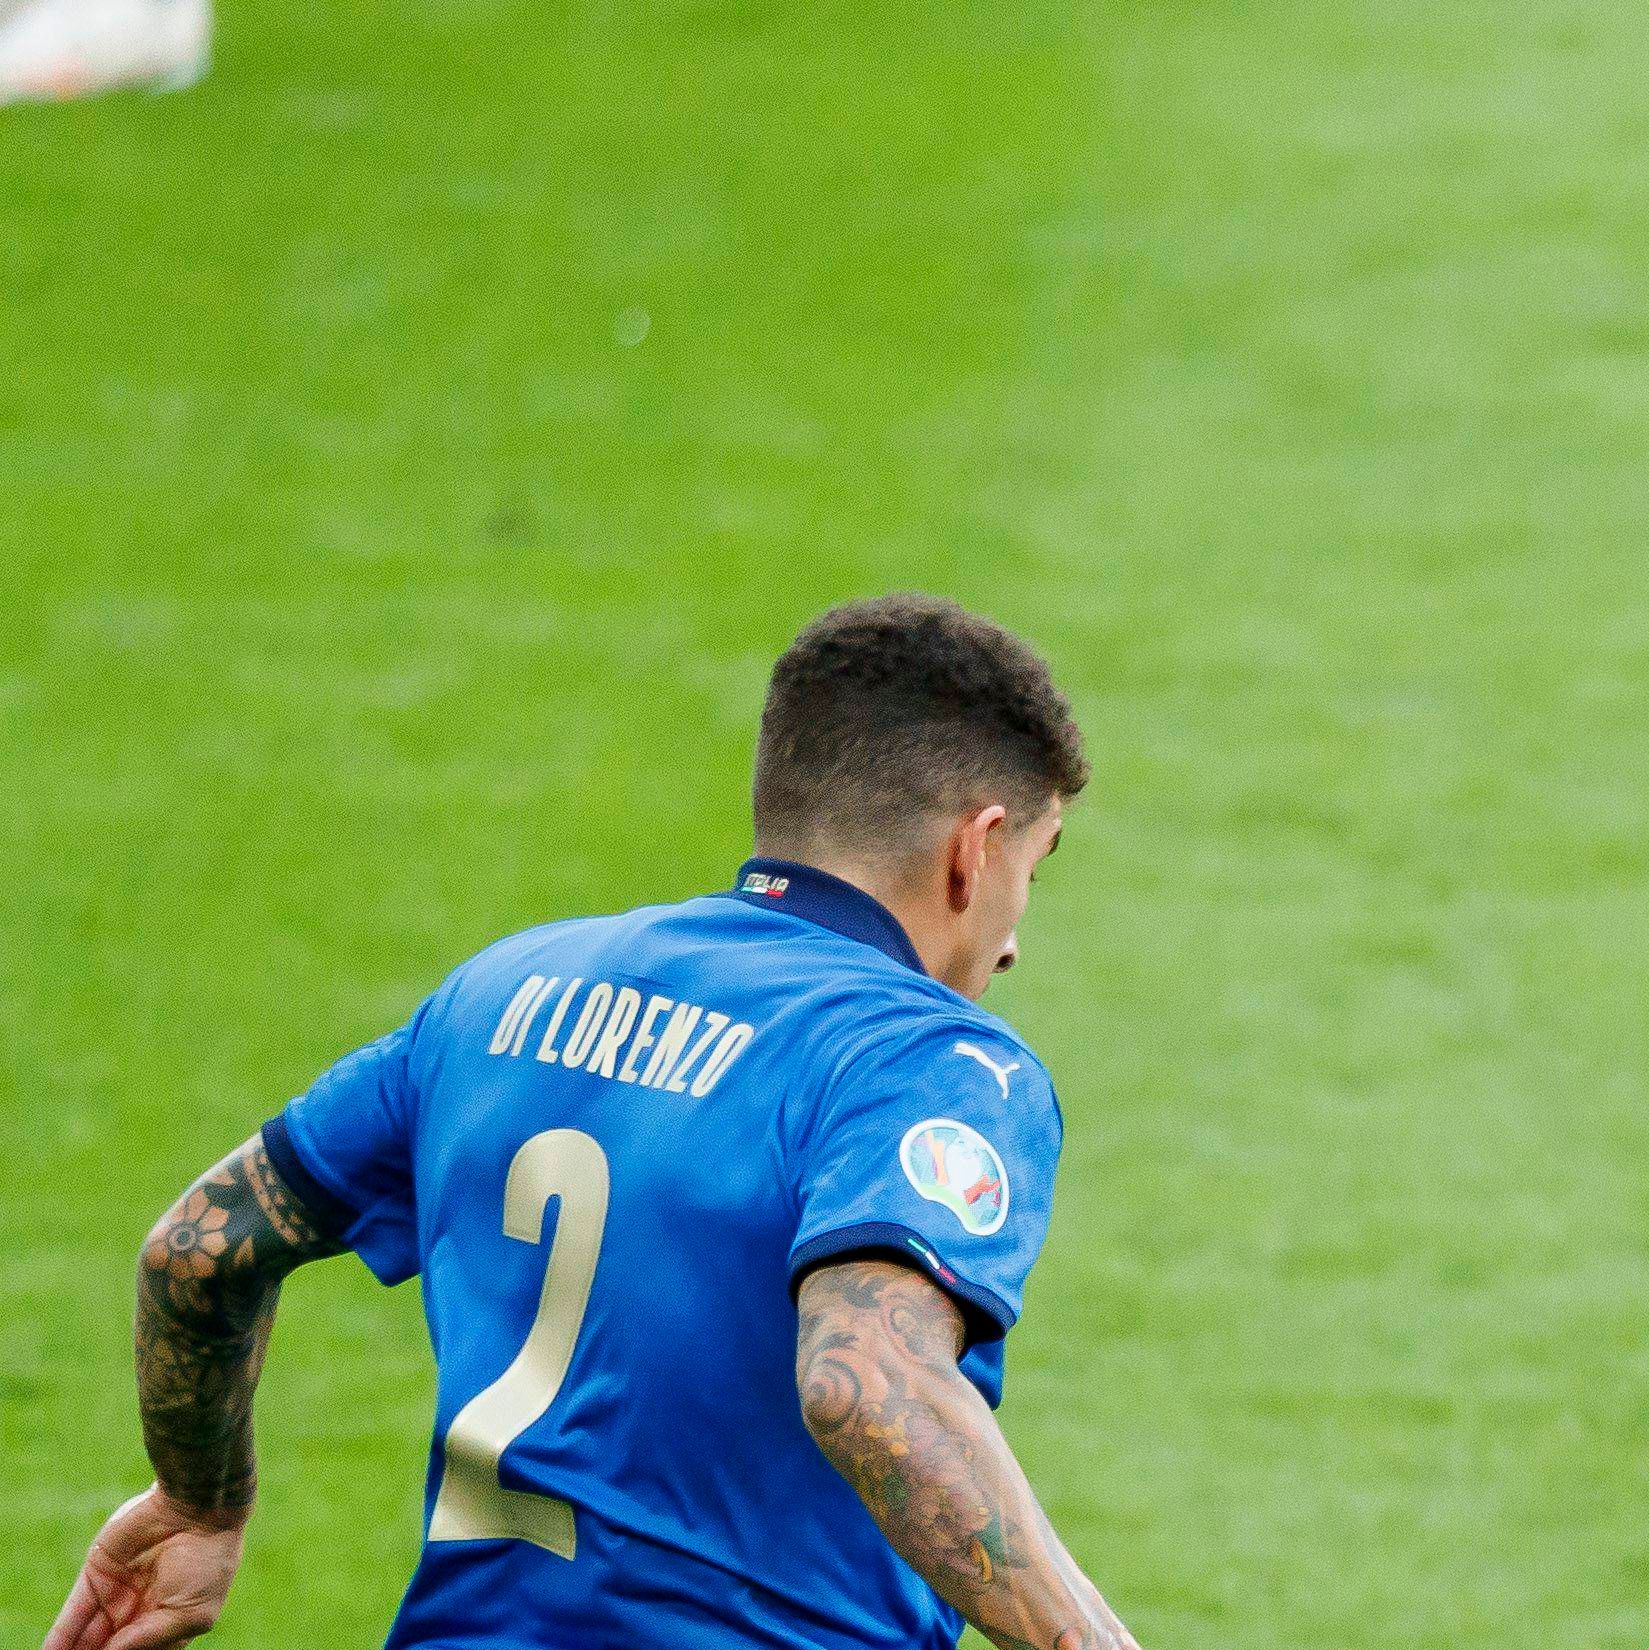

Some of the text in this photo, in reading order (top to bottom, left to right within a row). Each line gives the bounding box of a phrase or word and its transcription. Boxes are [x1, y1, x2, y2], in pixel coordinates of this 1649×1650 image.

[487, 974, 756, 1099] DI LORENZO
[427, 1127, 611, 1562] 2
